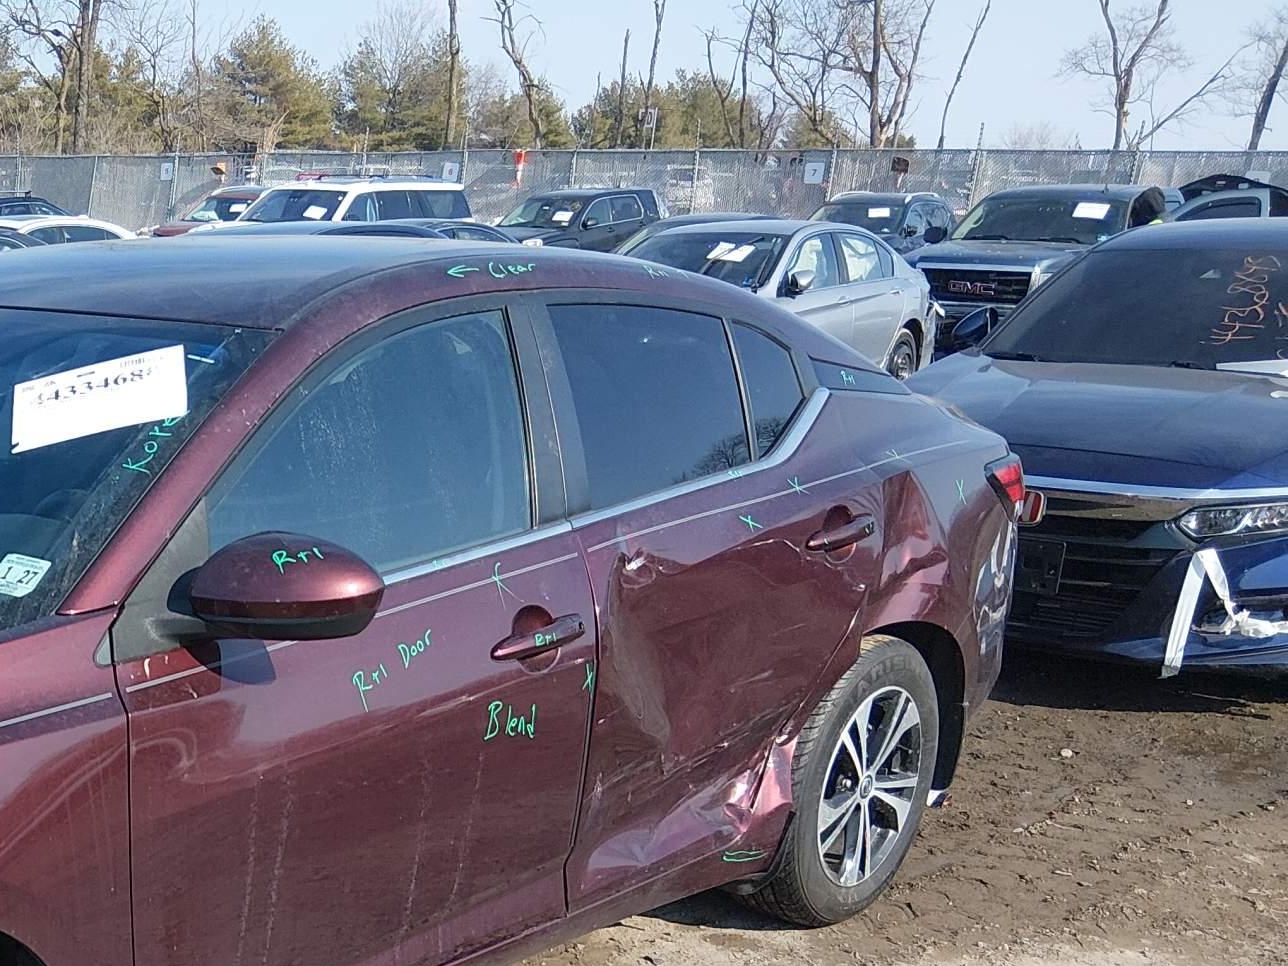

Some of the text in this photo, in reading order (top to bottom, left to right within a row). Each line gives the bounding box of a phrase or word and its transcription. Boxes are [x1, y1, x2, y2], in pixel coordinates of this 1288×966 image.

[488, 261, 536, 279] Clear
[948, 280, 996, 296] GMC
[0, 565, 40, 585] 1 27
[397, 628, 432, 669] Door
[482, 700, 537, 741] Blend
